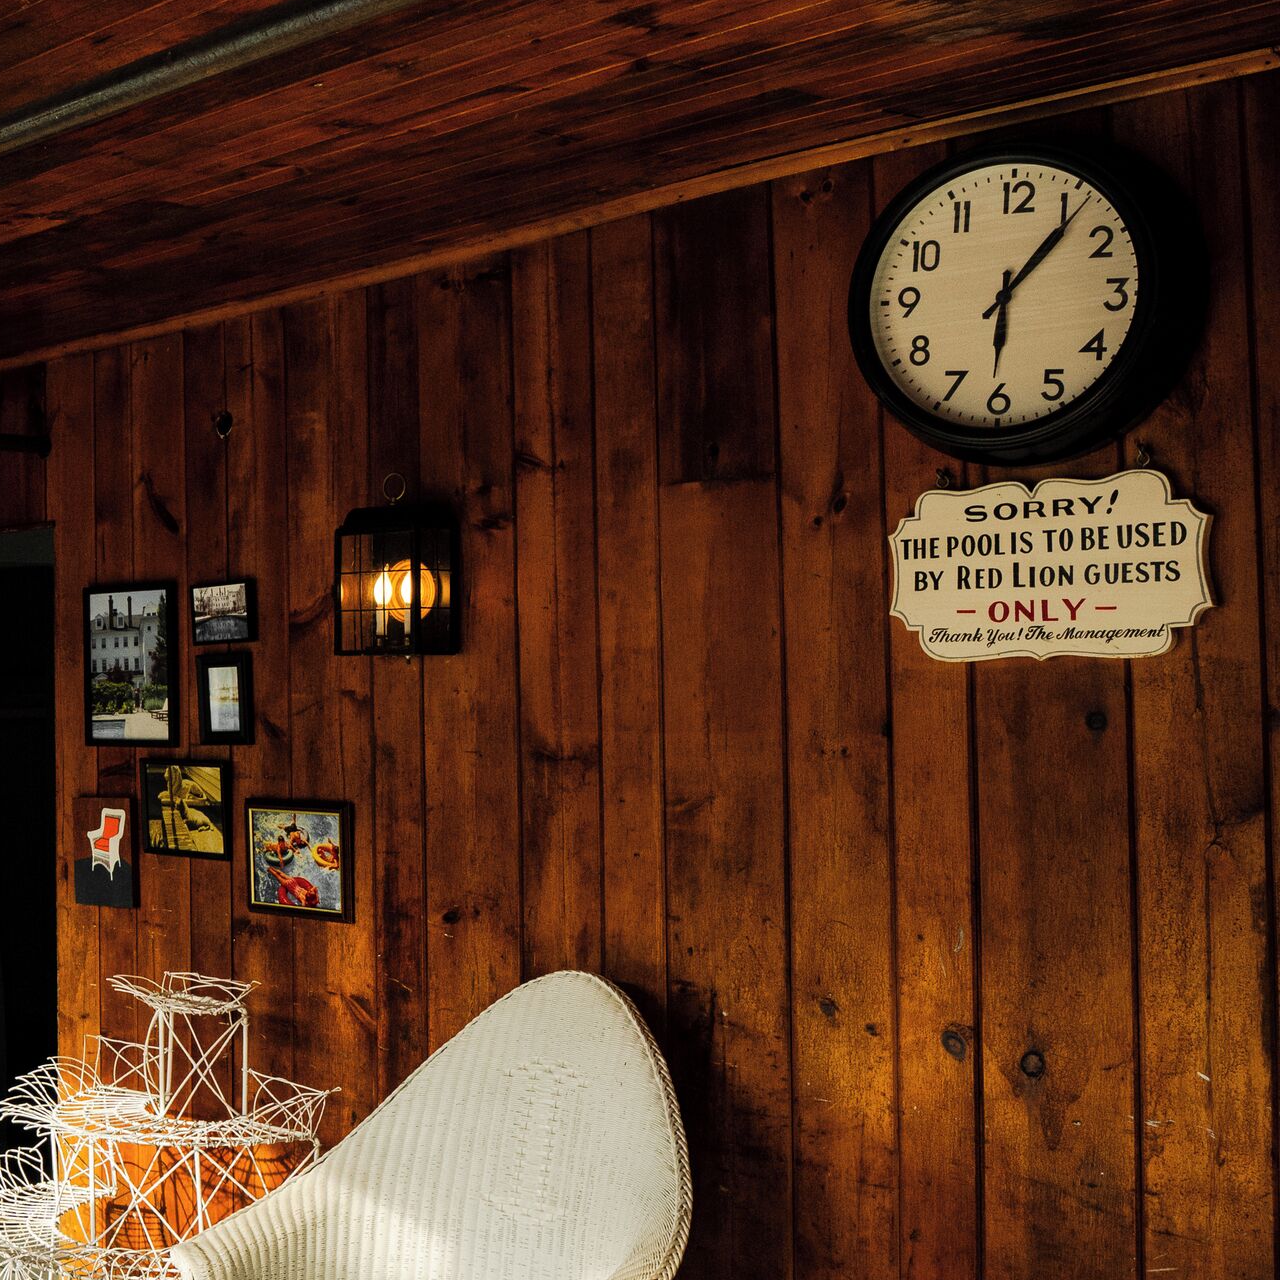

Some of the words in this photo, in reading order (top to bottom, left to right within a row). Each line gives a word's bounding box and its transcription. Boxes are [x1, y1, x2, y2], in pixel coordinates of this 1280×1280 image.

[1002, 180, 1036, 214] 12
[1061, 192, 1068, 230] 1
[953, 200, 971, 233] 11
[912, 240, 940, 272] 10
[1088, 225, 1114, 258] 2
[898, 286, 921, 318] 9
[1103, 278, 1130, 311] 3
[909, 335, 930, 366] 8
[1078, 328, 1108, 360] 4
[942, 370, 969, 401] 7
[986, 383, 1011, 415] 6
[1040, 368, 1065, 401] 5
[964, 489, 1119, 522] SORRY!
[900, 537, 940, 560] THE
[947, 534, 1006, 558] POOL
[1011, 531, 1033, 554] IS
[1043, 528, 1073, 552] TO
[1081, 526, 1109, 551] BE
[1116, 521, 1187, 549] USED
[914, 571, 944, 591] BY
[957, 566, 1003, 590] RED
[1012, 562, 1074, 588] LION
[1084, 560, 1181, 585] GUESTS
[988, 598, 1086, 623] ONLY
[929, 627, 985, 644] Thank
[987, 627, 1022, 647] You!
[1025, 625, 1054, 642] The
[1056, 623, 1166, 644] Management
